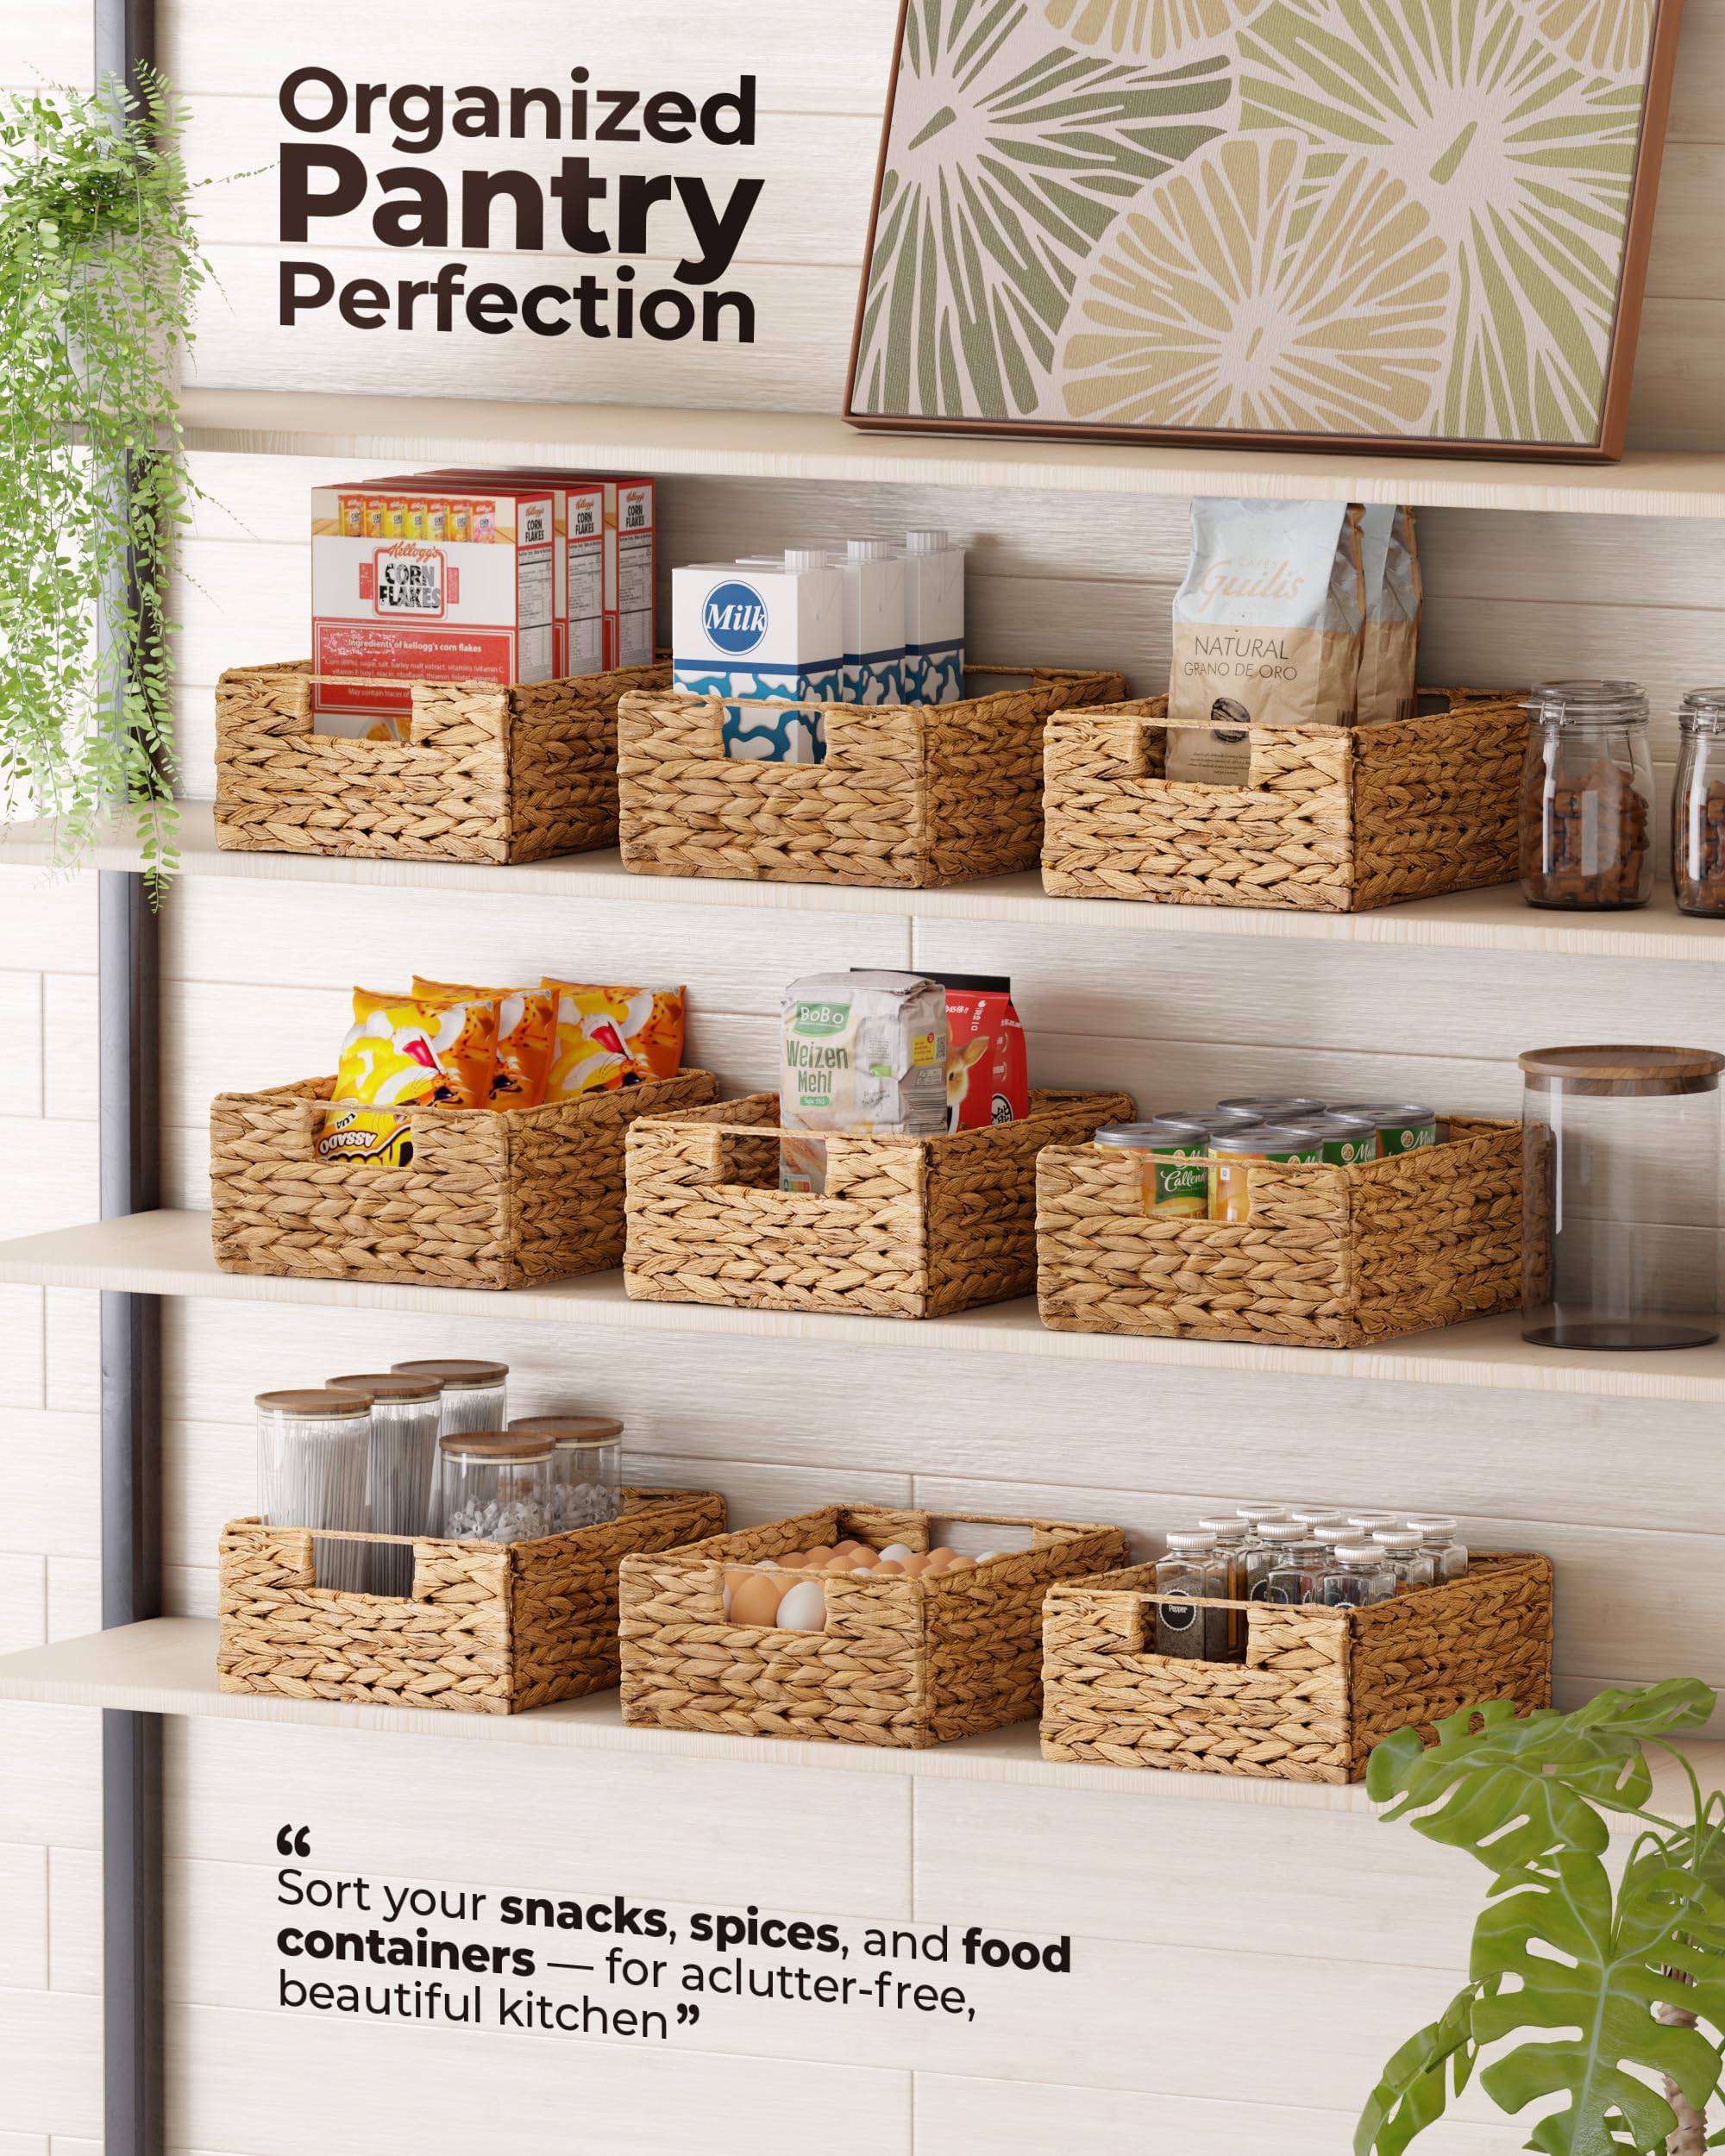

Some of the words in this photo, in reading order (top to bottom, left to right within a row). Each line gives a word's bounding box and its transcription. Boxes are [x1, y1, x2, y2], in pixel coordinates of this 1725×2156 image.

[577, 511, 593, 523] CORN
[627, 505, 643, 516] CORN
[526, 518, 543, 531] CORN
[575, 523, 594, 536] FLAKES
[625, 516, 645, 528] FLAKES
[525, 530, 544, 542] FLAKES
[388, 540, 439, 563] Kellogg's
[385, 563, 435, 587] CORN
[1196, 560, 1304, 614] Guilis
[379, 585, 441, 609] FLAKES
[706, 603, 766, 632] Milk
[348, 638, 392, 649] Ingredients
[393, 640, 404, 649] of
[404, 641, 439, 653] kellogg's
[440, 643, 457, 652] corn
[458, 642, 482, 653] flakes
[1195, 636, 1289, 660] NATURAL
[1184, 662, 1230, 676] GRANO
[1234, 662, 1253, 677] DE
[1258, 664, 1297, 681] ORO
[787, 1039, 849, 1069] Weizen
[798, 1069, 832, 1094] Mehl
[336, 1112, 356, 1130] LUA
[319, 1131, 377, 1154] ASSADO
[1168, 1604, 1188, 1614] Pepper
